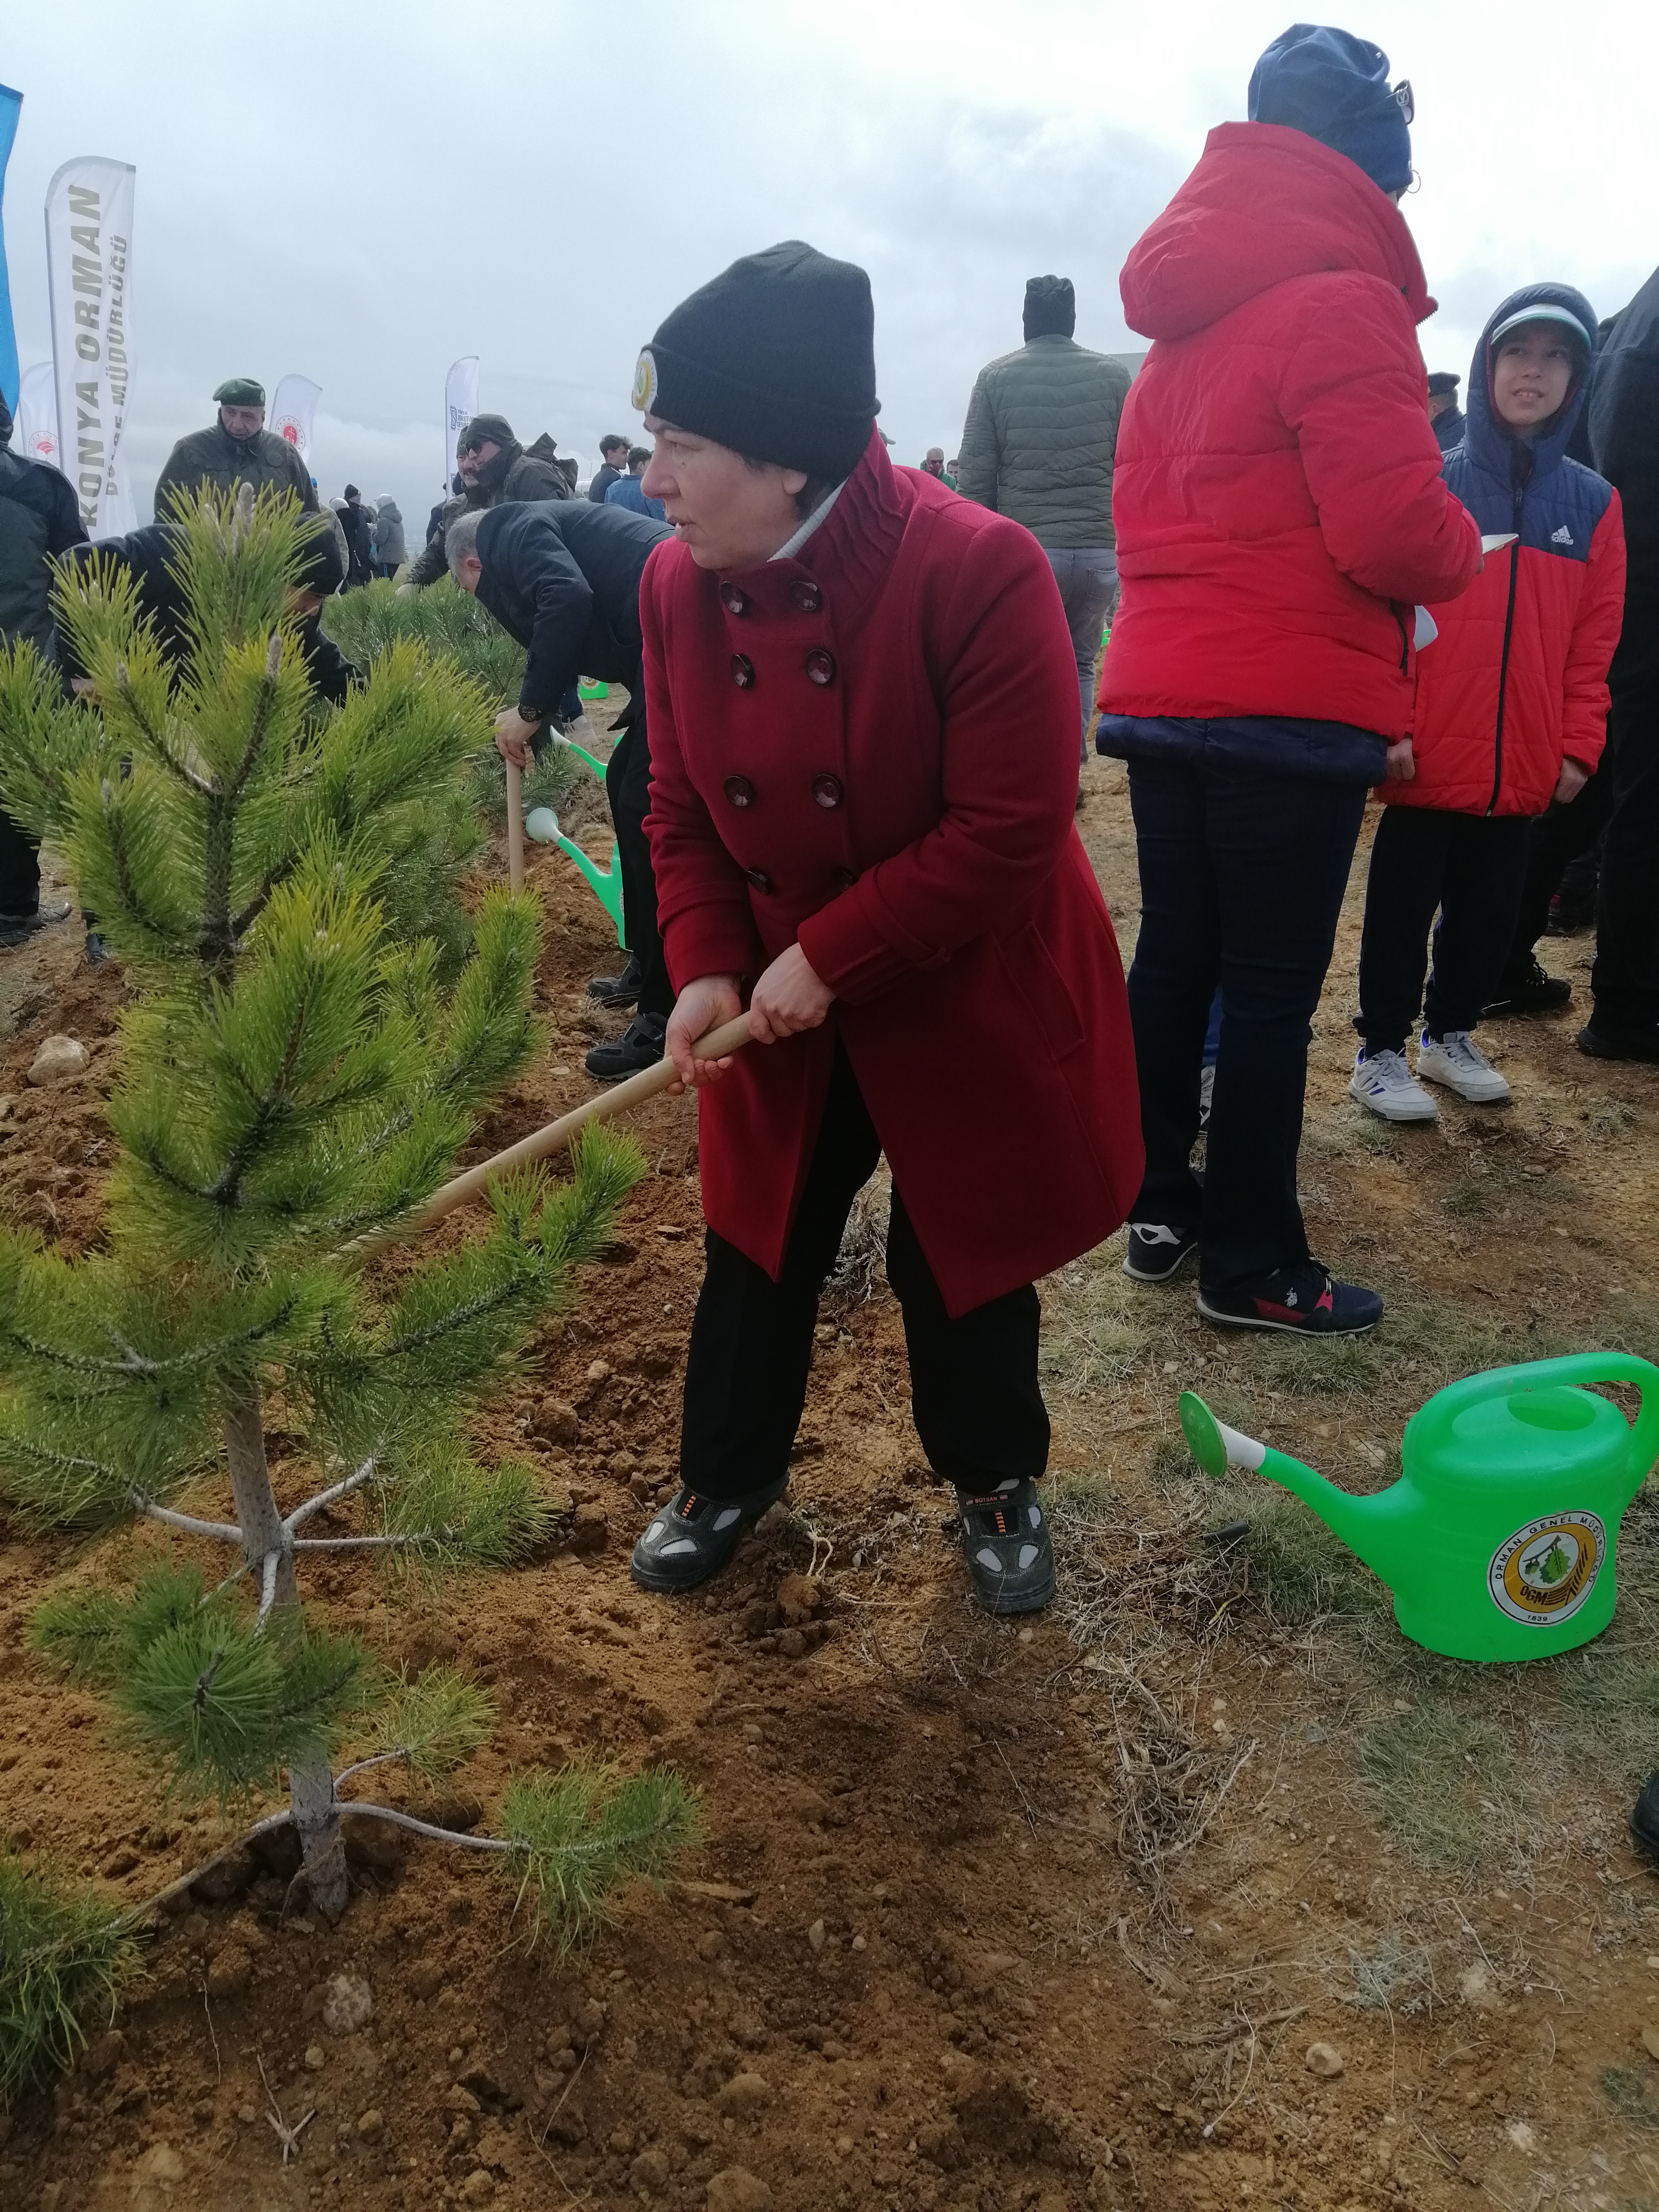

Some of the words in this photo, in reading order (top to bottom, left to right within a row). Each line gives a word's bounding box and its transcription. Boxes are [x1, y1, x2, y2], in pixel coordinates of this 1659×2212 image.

[68, 184, 102, 362] ORMAN
[105, 234, 129, 407] MÜDÜRLÜĞÜ
[75, 381, 105, 527] KONYA
[1551, 535, 1574, 545] adidas
[1495, 1538, 1522, 1580] ORMAN
[1529, 1516, 1573, 1534] GENEL
[1520, 1585, 1548, 1605] OGM
